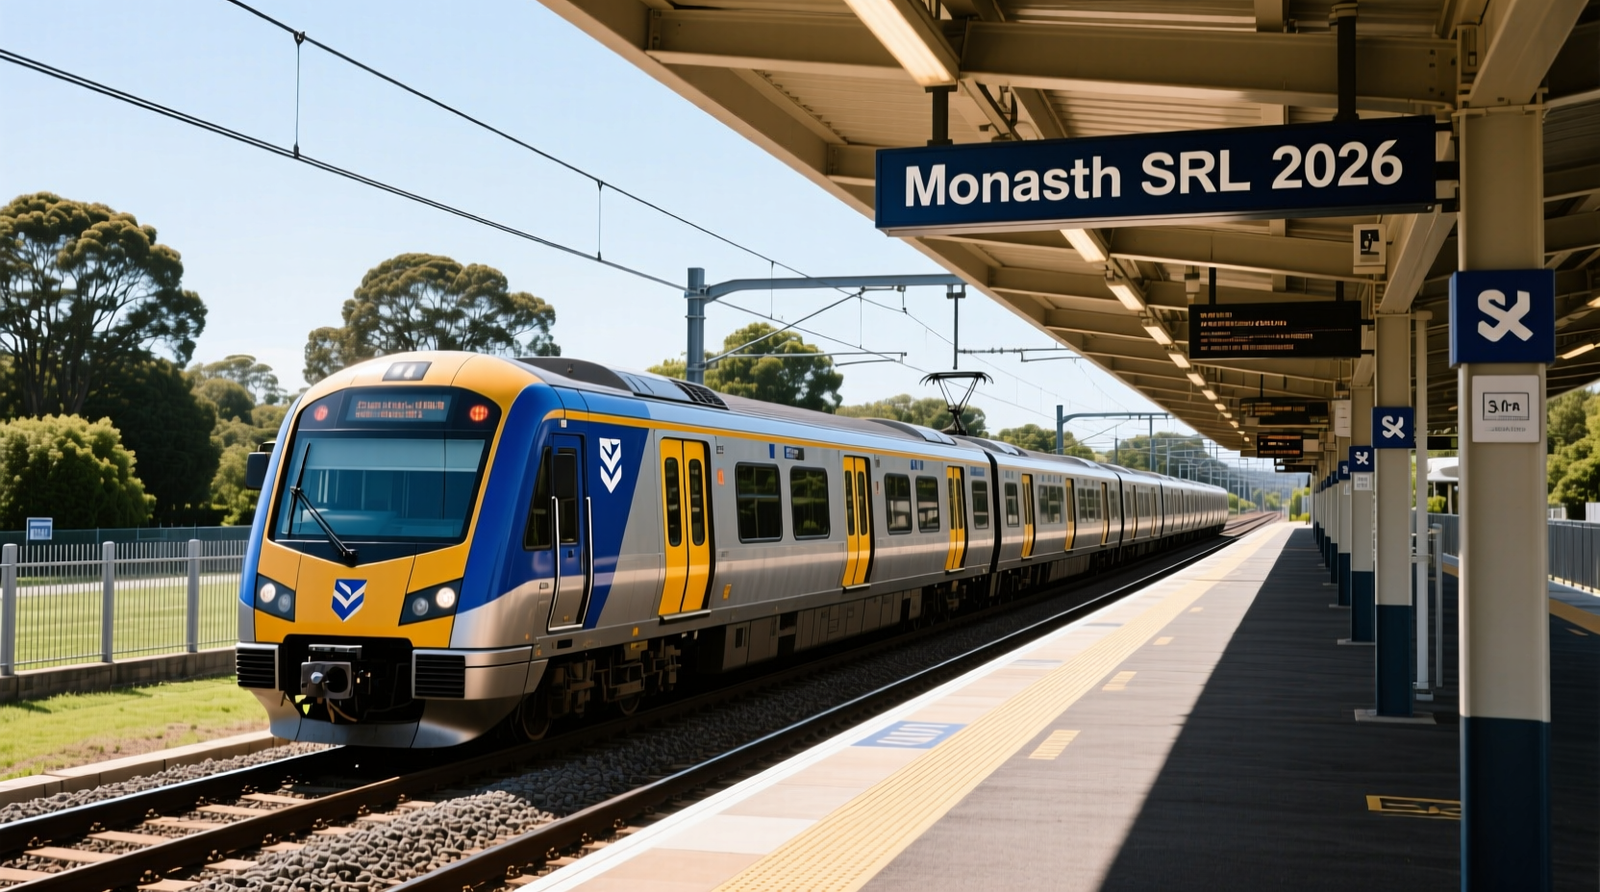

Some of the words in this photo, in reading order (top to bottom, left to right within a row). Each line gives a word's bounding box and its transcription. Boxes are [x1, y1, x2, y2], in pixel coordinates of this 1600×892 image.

[905, 155, 1121, 207] Monasth
[1141, 149, 1251, 196] SRL
[1271, 139, 1403, 190] 2026
